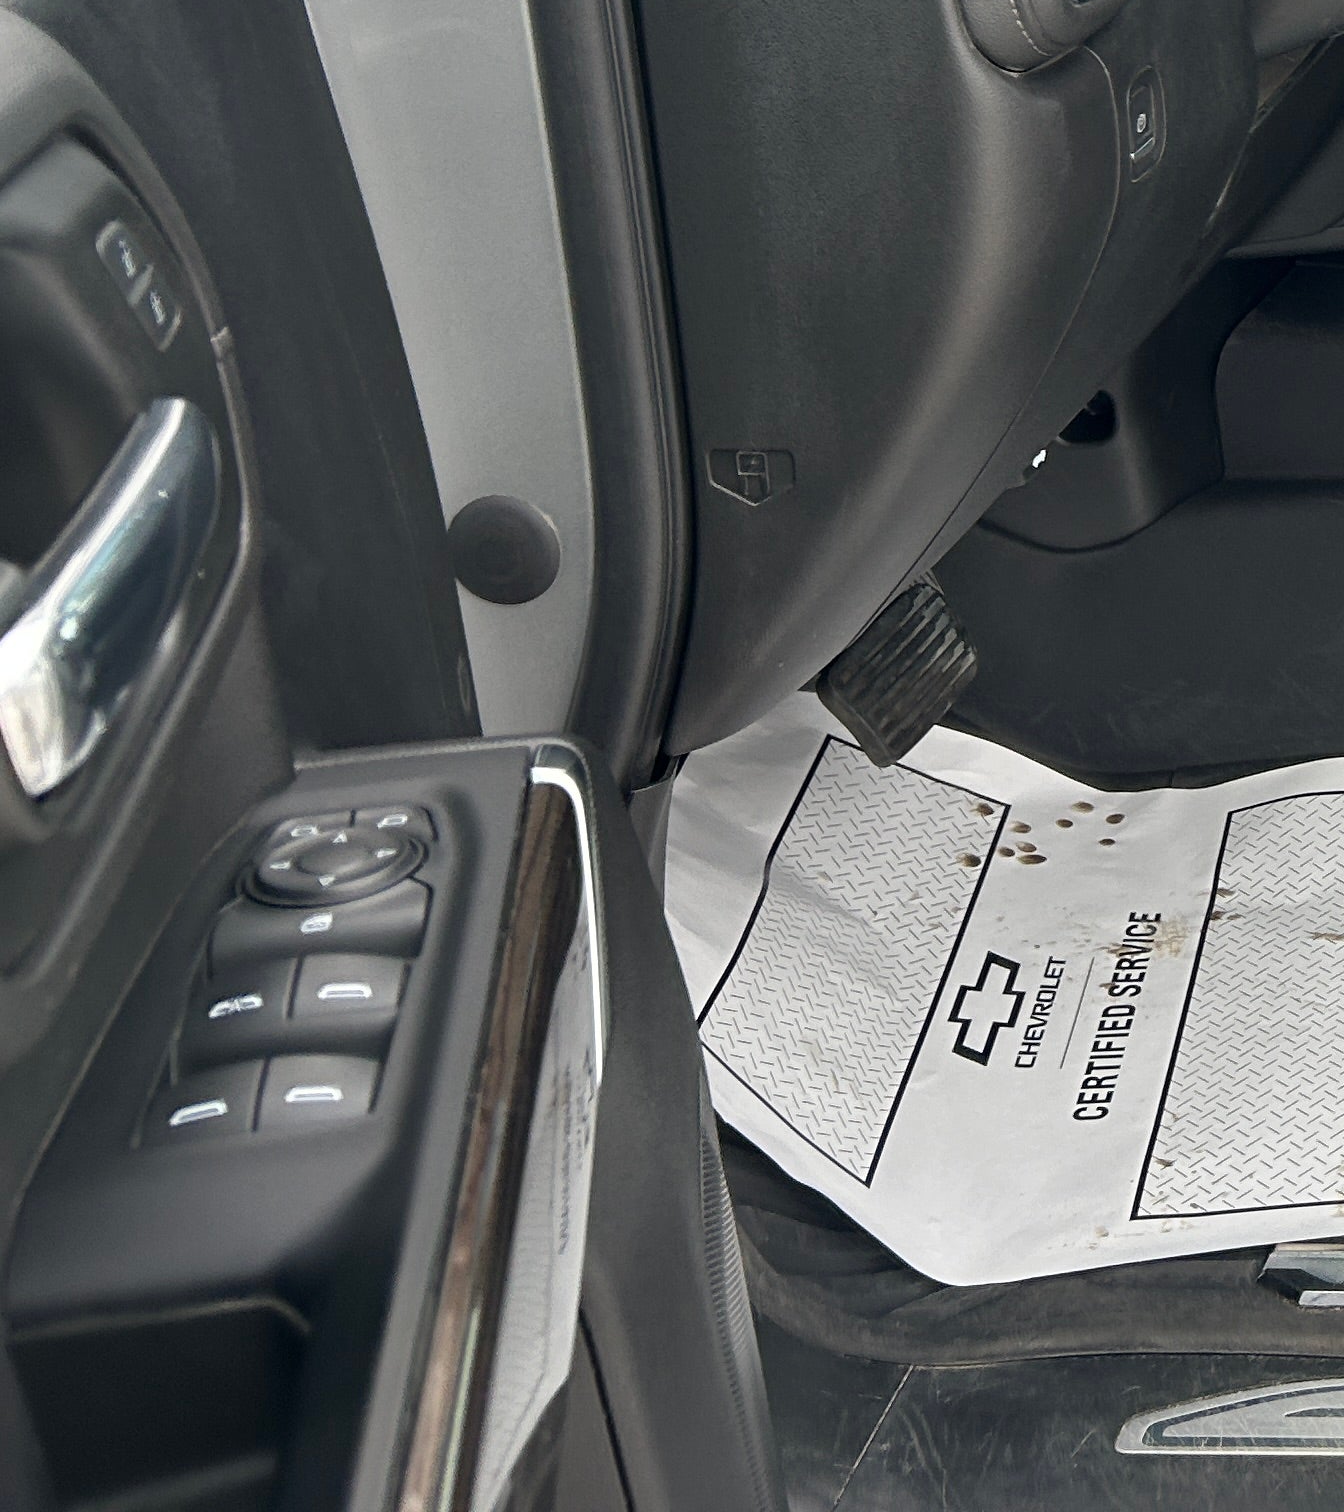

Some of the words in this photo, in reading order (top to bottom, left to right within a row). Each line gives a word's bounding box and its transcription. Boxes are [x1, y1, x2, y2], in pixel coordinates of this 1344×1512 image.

[1014, 956, 1066, 1068] CHEVROLET
[1072, 1004, 1136, 1121] CERTIFIED
[1108, 911, 1162, 997] SERVICE
